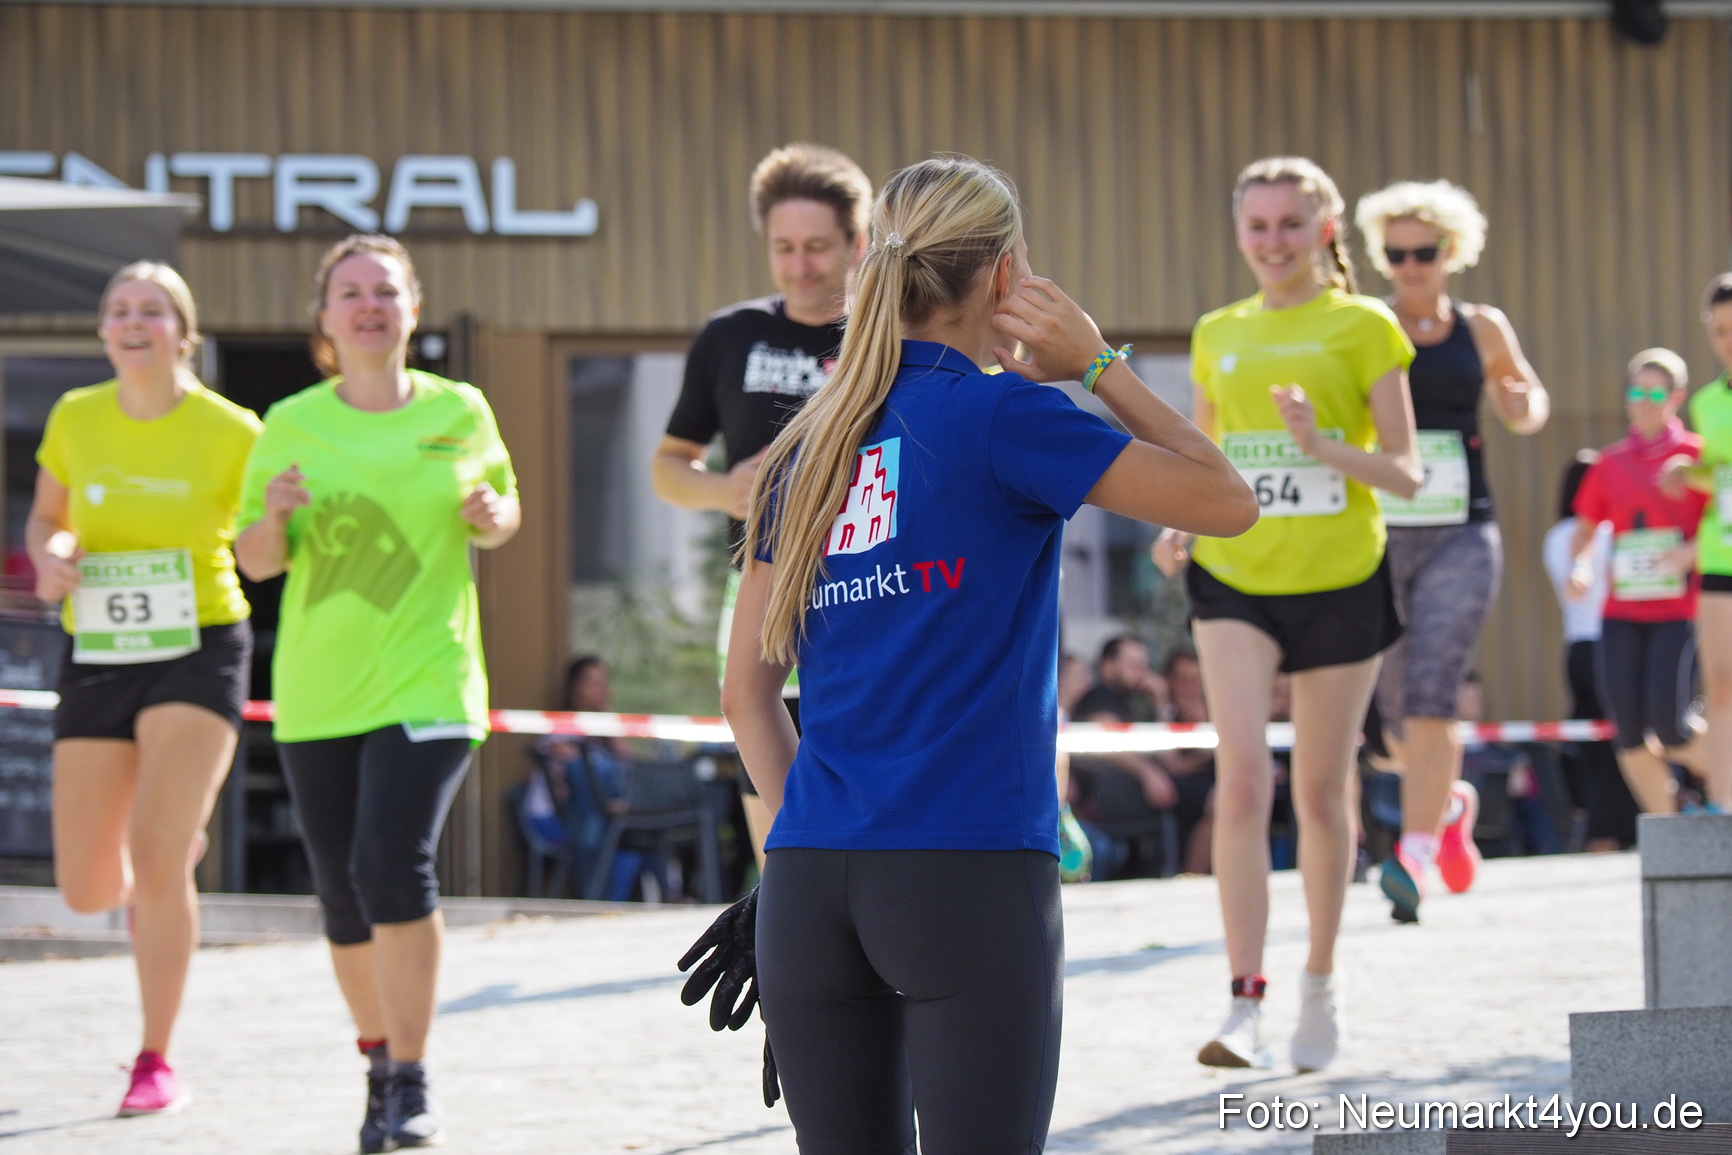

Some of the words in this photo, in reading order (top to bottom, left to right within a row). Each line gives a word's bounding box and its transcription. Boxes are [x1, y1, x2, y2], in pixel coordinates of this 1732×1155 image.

[1230, 439, 1304, 461] BOC
[1254, 473, 1301, 507] 64
[80, 556, 179, 580] BOCK
[806, 563, 910, 611] umarkt
[912, 557, 966, 593] TV
[106, 591, 152, 624] 63
